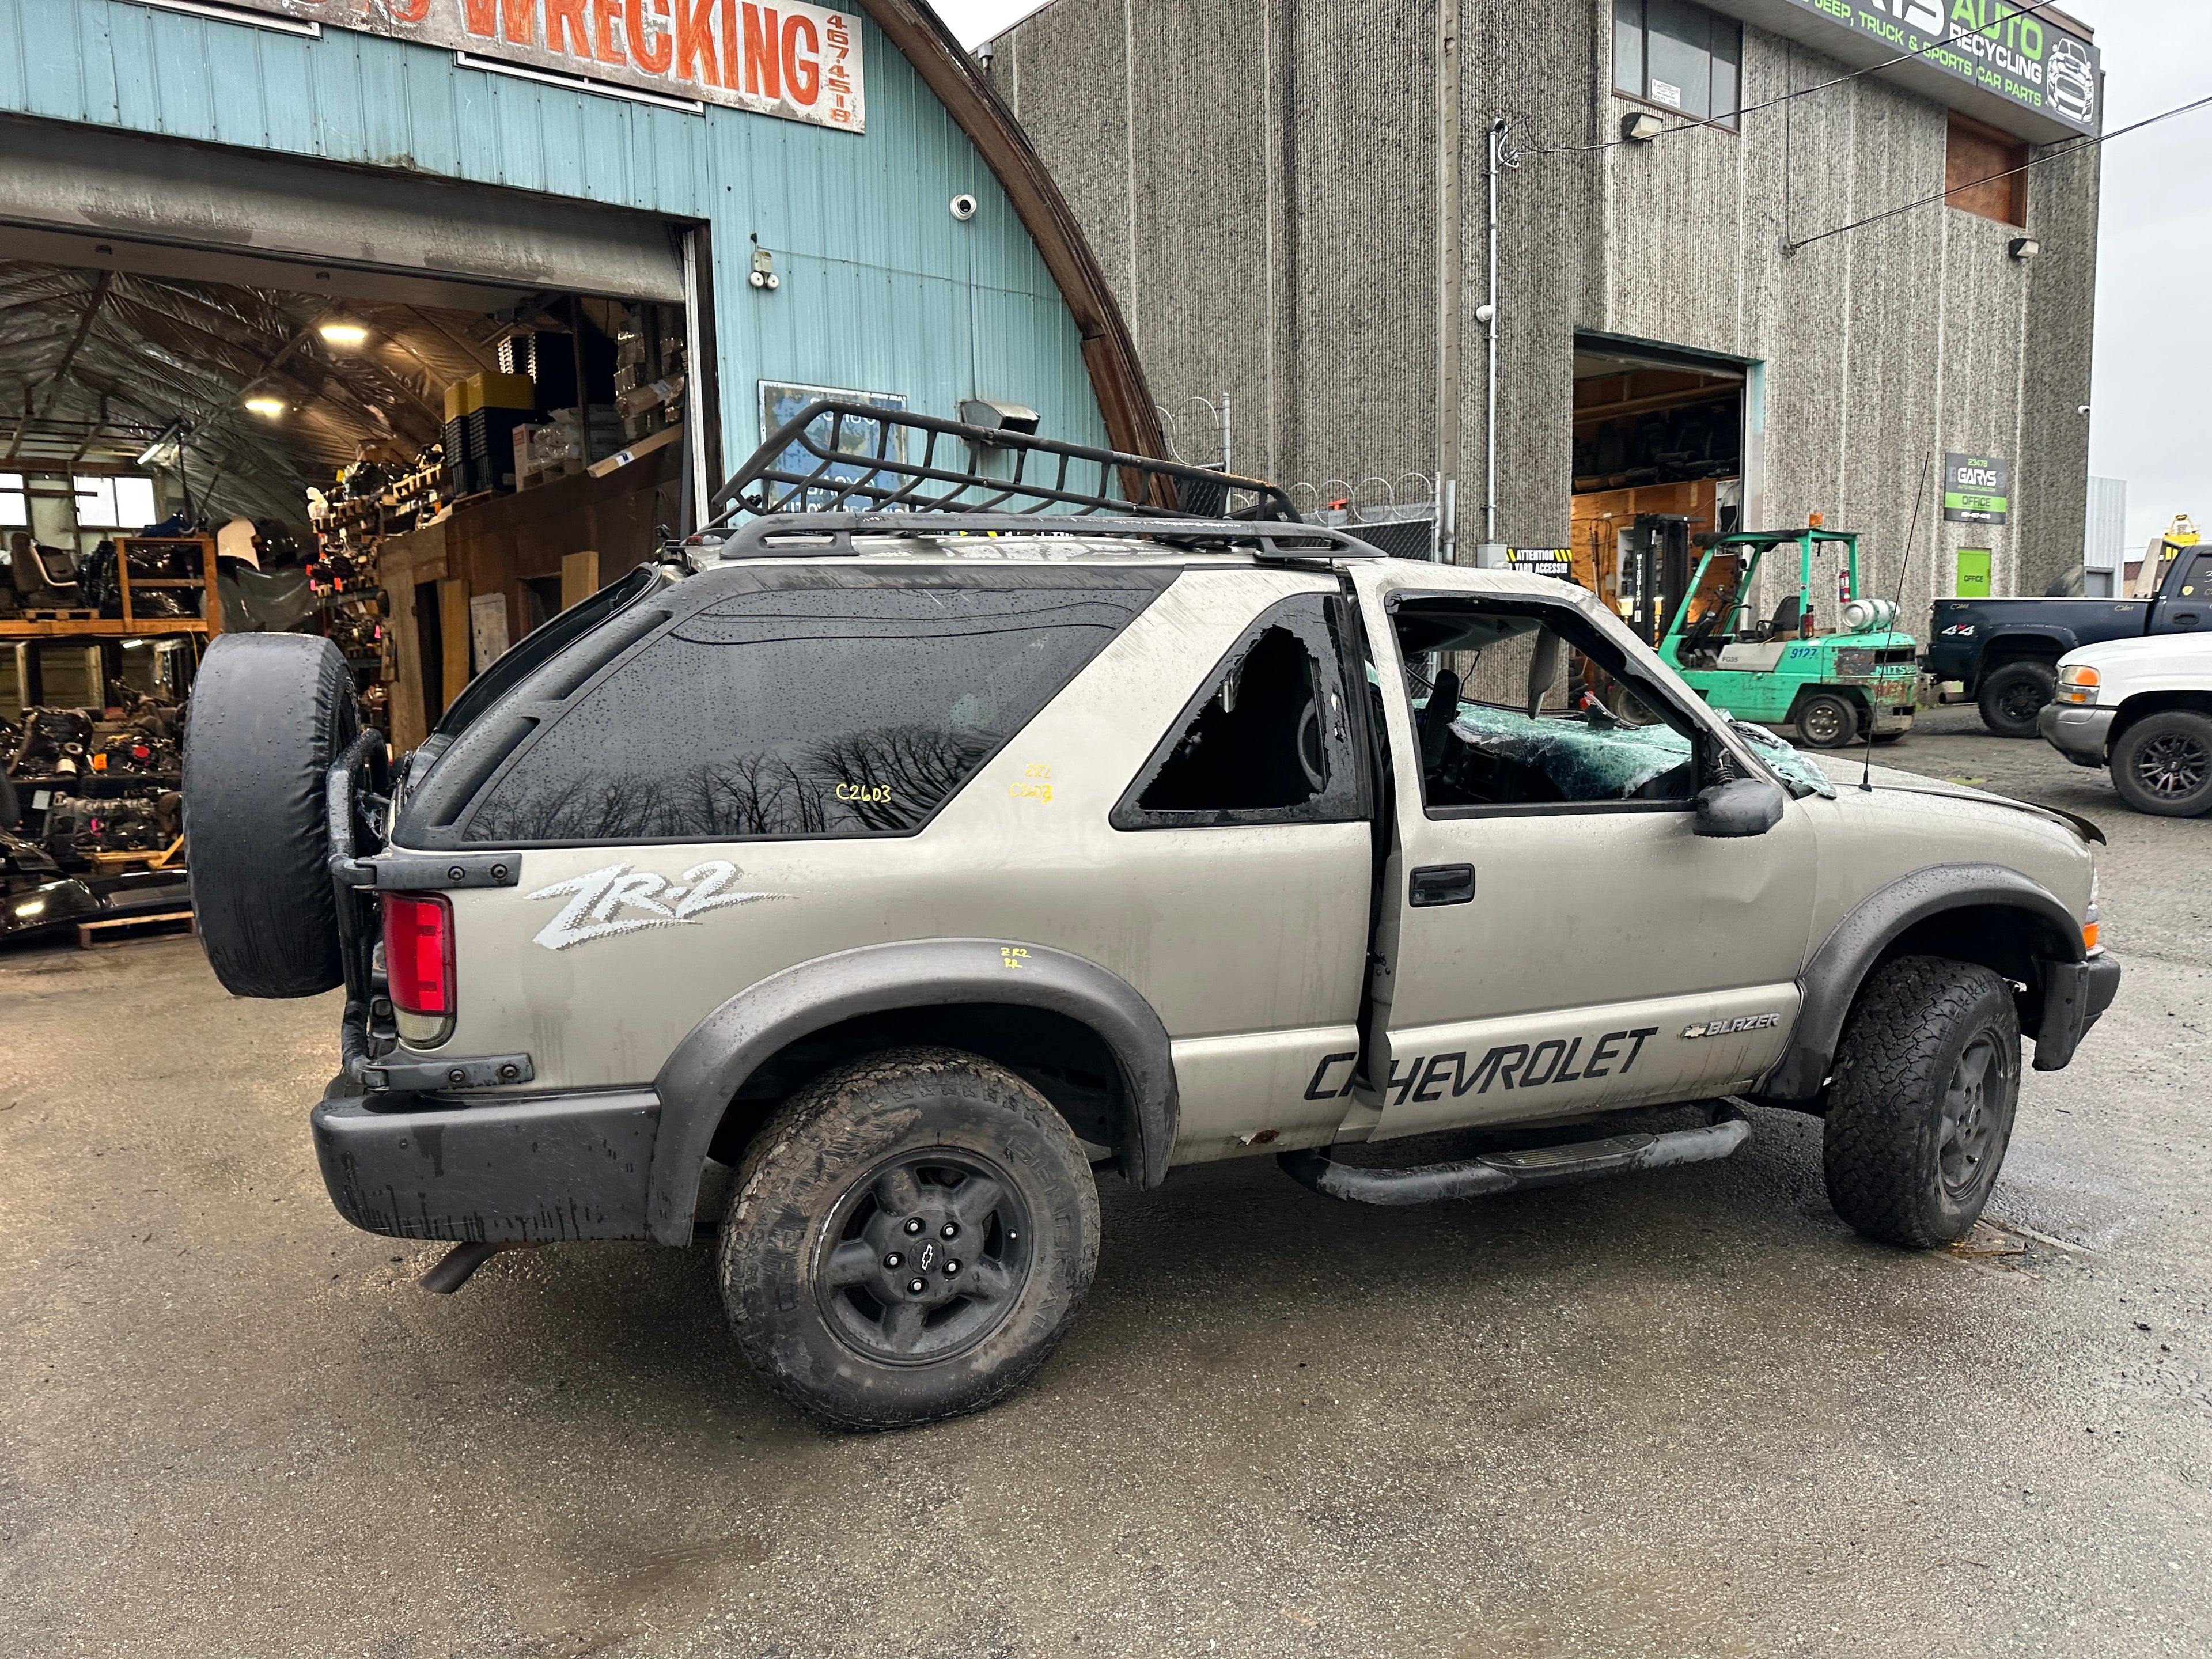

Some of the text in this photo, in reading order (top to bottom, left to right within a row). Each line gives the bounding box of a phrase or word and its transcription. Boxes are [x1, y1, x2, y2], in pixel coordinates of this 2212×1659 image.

[1950, 0, 2043, 60] AUTO
[1858, 10, 1904, 46] TRUCK
[1908, 35, 1919, 51] &
[1923, 41, 1972, 76] SPORTS
[1976, 66, 2002, 89] CAR
[2005, 78, 2041, 107] PARTS
[1949, 22, 2043, 85] RECYCLING
[1957, 467, 1997, 487] GARYS
[1962, 495, 1991, 507] OFFICE
[1516, 549, 1554, 561] ATTENTION
[836, 783, 891, 803] C2603
[1010, 782, 1054, 804] C2603
[1705, 1012, 1780, 1037] BLAZER
